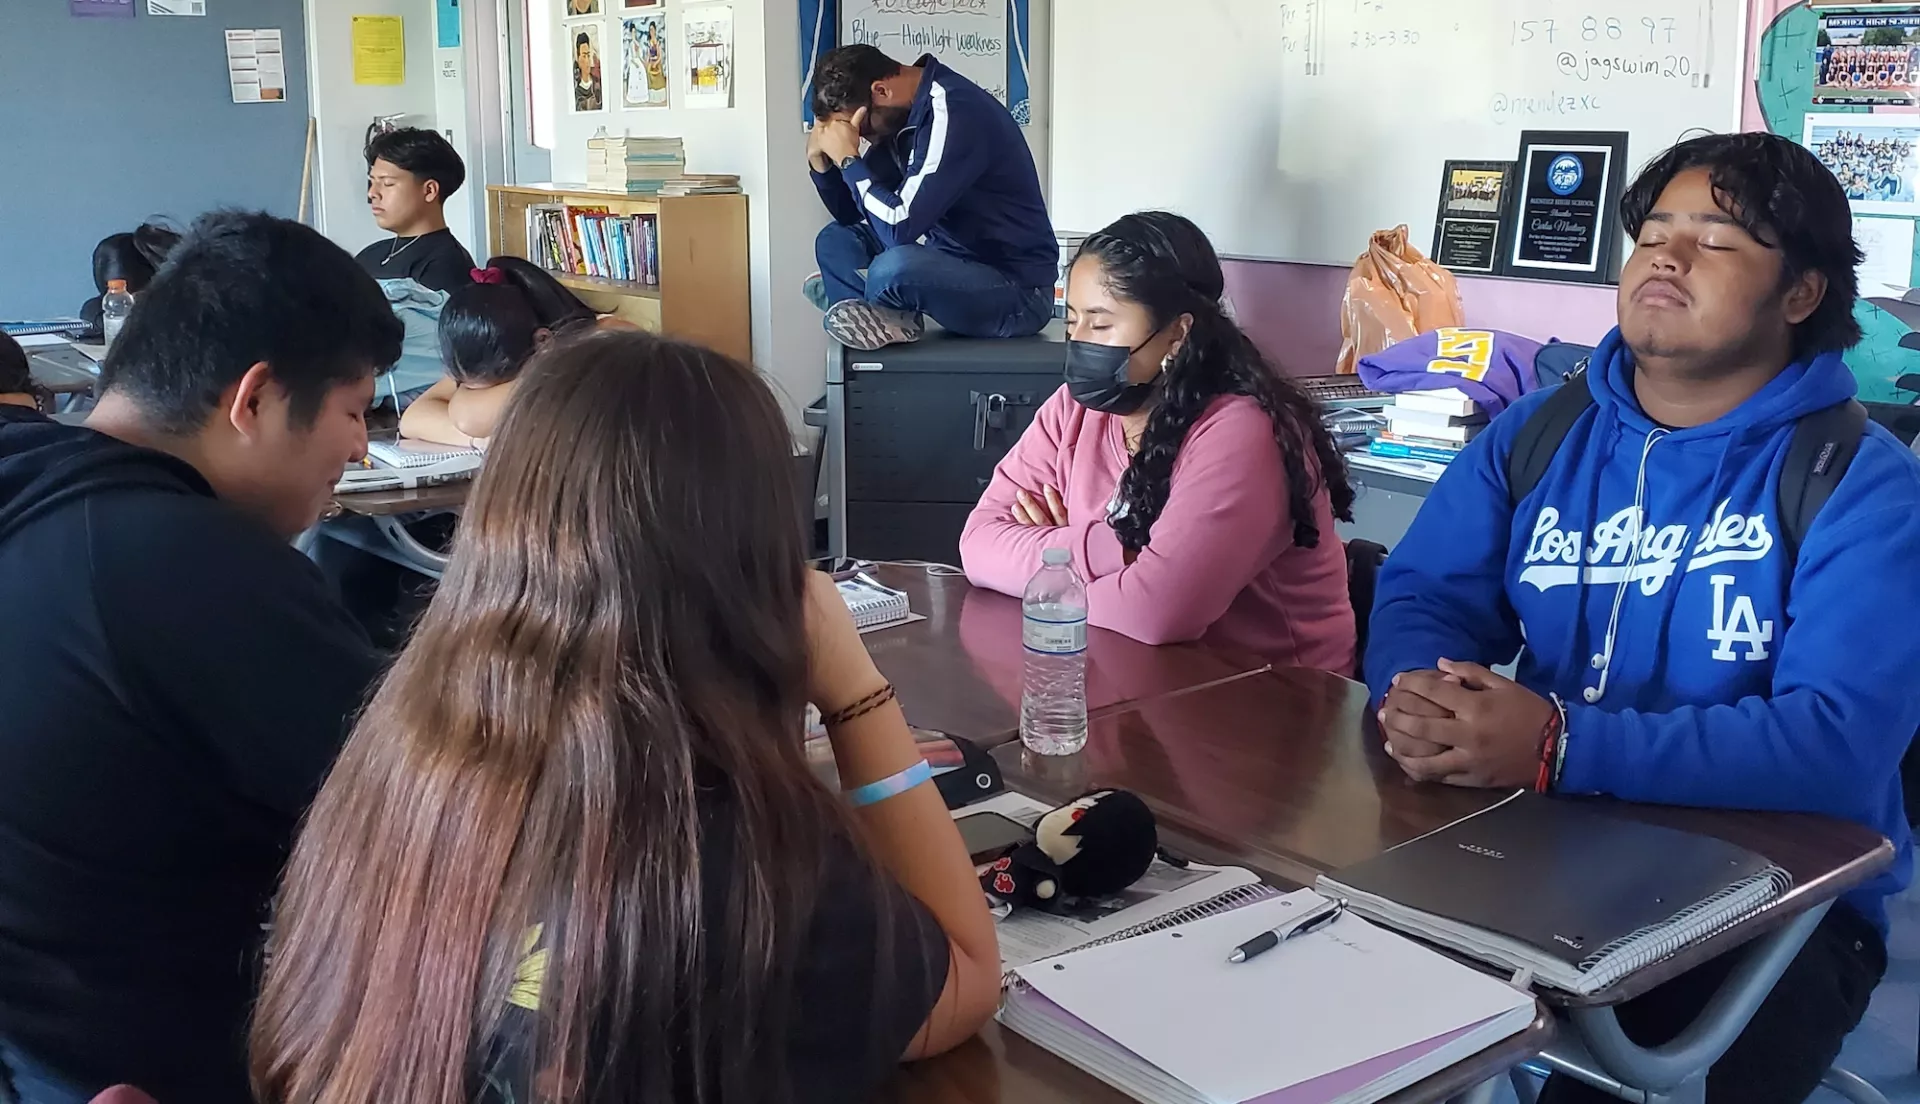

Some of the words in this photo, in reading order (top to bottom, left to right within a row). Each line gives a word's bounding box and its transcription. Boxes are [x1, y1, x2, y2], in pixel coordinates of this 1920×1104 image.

[1510, 19, 1560, 46] 157
[1581, 16, 1622, 41] 88
[1641, 17, 1677, 44] 97
[1865, 18, 1888, 26] HIGH
[1524, 506, 1582, 563] Los
[1707, 574, 1773, 661] LA
